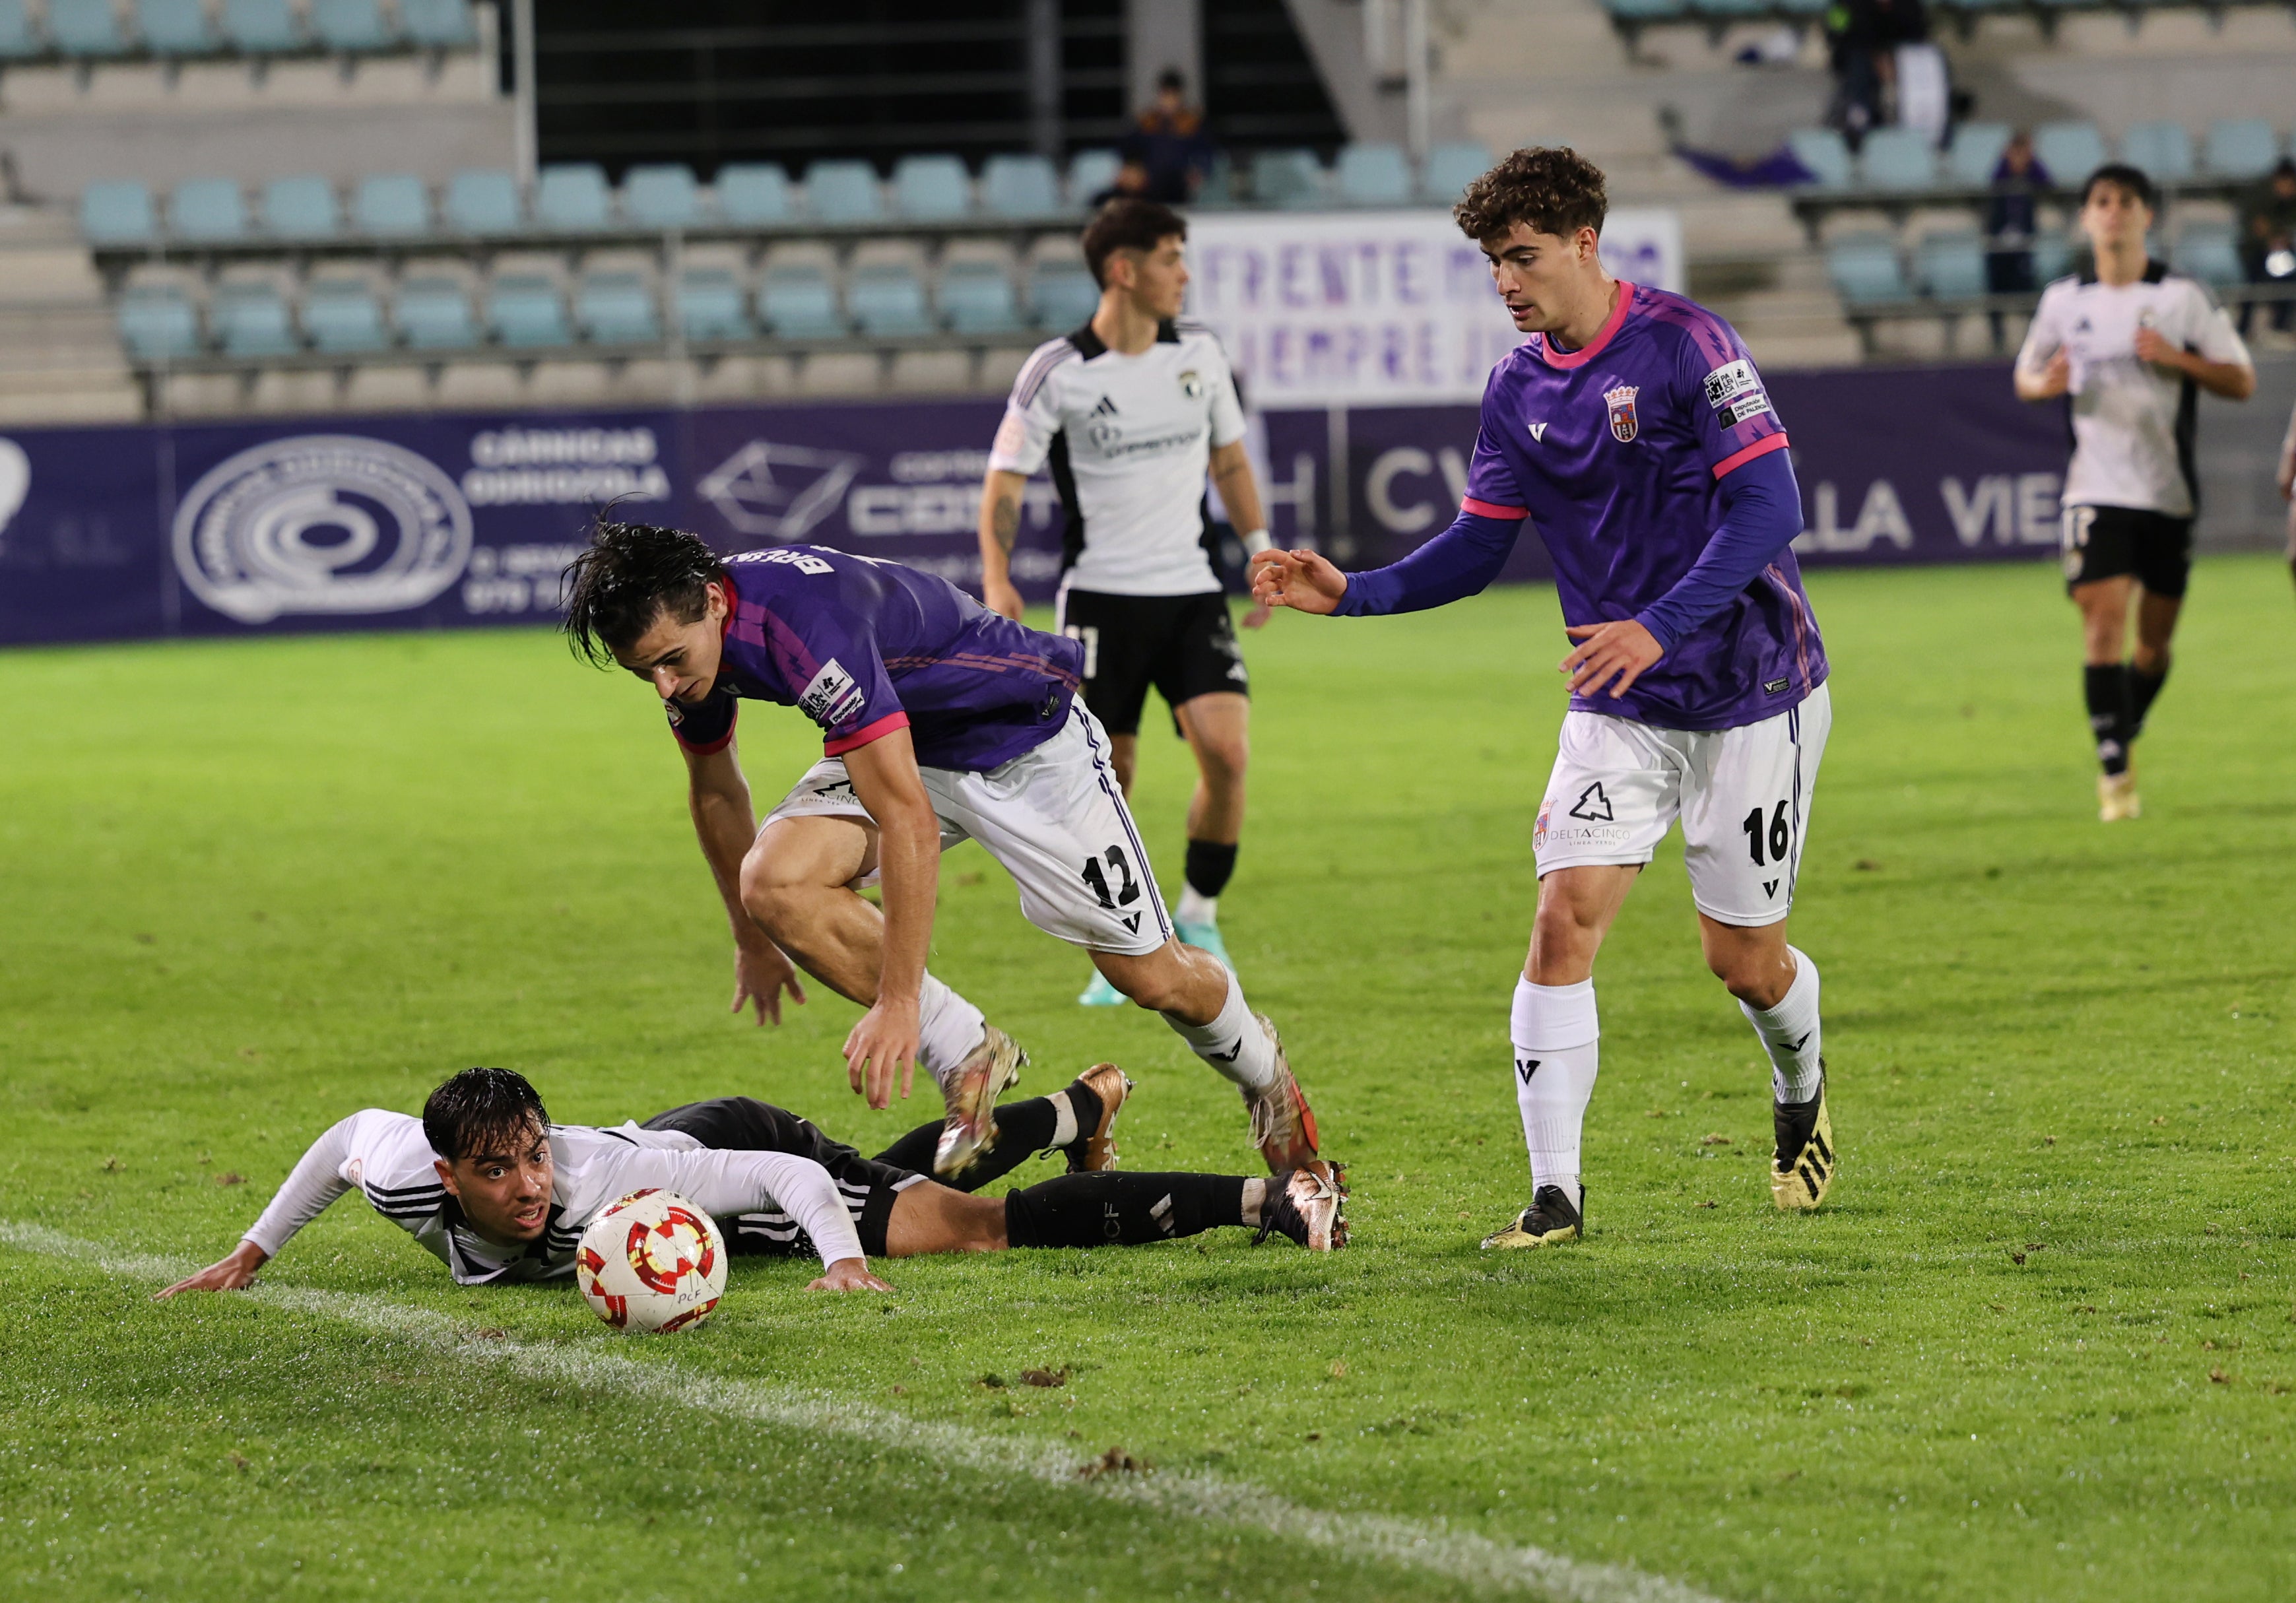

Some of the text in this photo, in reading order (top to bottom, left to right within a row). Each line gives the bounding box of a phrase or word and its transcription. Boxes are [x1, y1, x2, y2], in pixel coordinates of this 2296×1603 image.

[1200, 240, 1429, 309] FRENTE
[1552, 828, 1630, 840] DELTACINCO
[1744, 800, 1789, 867] 16
[1082, 845, 1140, 909] 12
[678, 1289, 702, 1304] PCF
